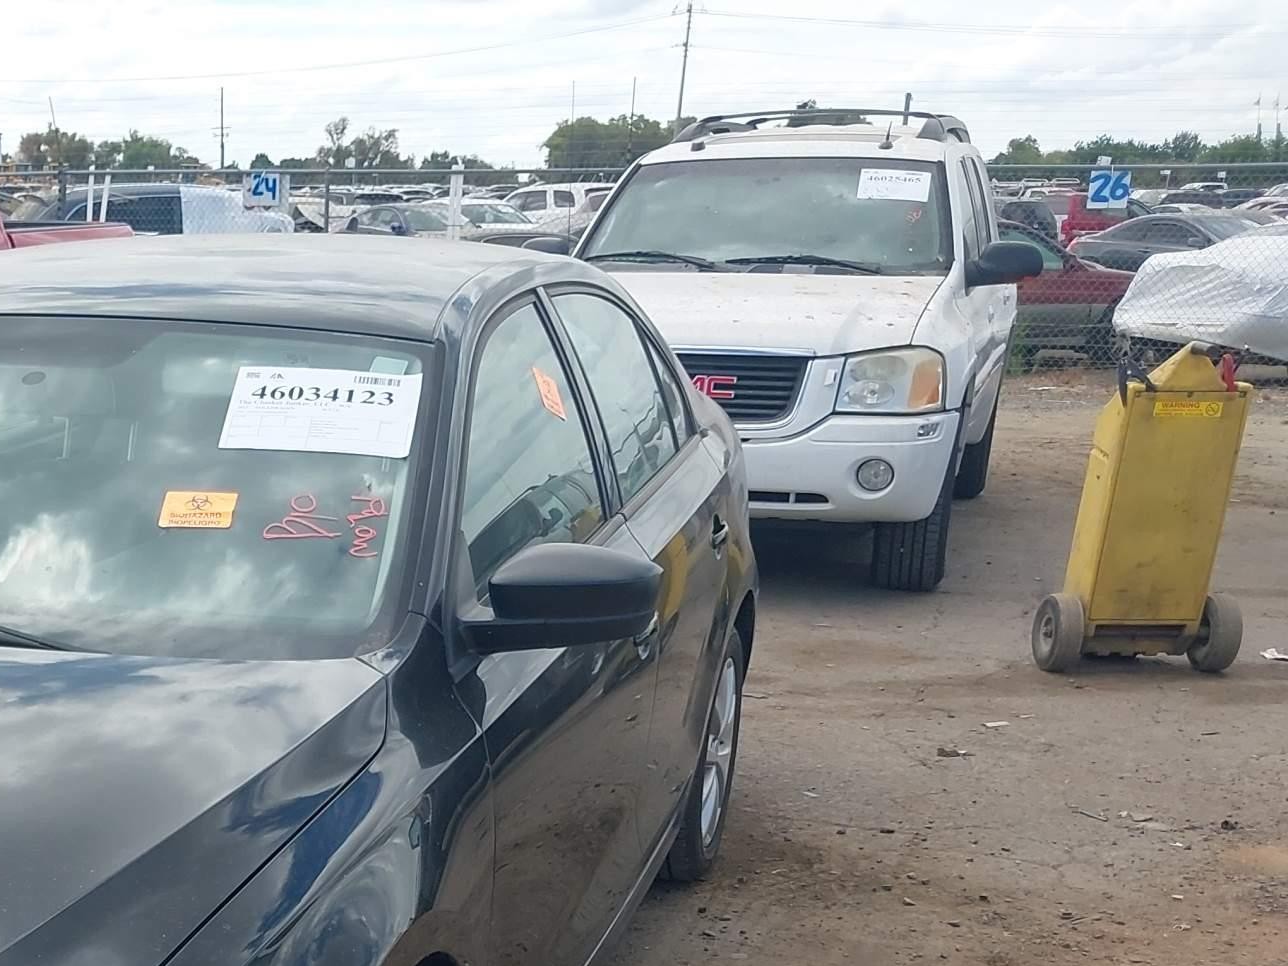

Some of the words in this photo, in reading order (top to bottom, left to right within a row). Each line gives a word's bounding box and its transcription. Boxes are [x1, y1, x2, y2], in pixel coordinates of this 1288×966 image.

[252, 174, 277, 200] 24
[1089, 170, 1129, 202] 26
[251, 384, 395, 407] 46034123
